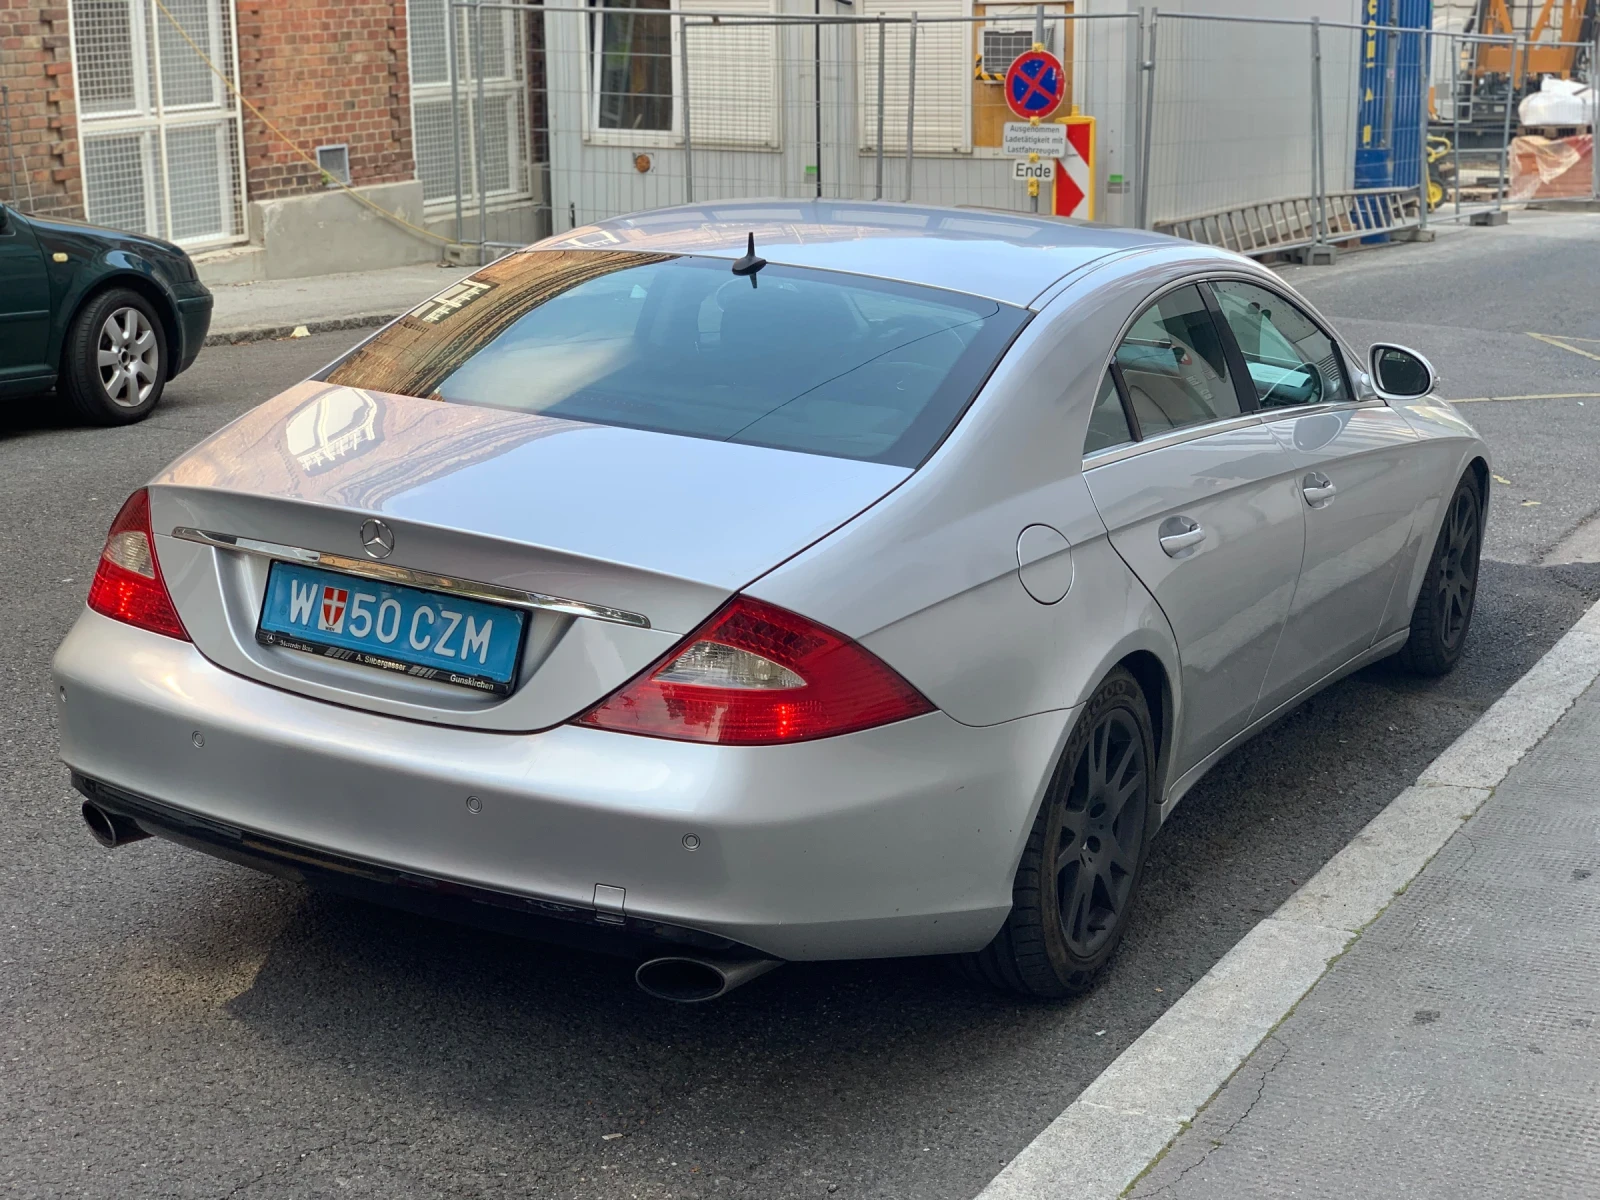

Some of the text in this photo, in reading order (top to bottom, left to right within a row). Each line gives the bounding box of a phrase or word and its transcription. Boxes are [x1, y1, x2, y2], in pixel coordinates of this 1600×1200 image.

[1010, 125, 1060, 133] Ausgenommen
[1005, 135, 1050, 144] Ladetätigkeit
[1007, 146, 1060, 155] Lastfahrzeugen
[1016, 163, 1051, 178] Ende
[290, 579, 493, 664] W 50 CZM
[450, 674, 494, 690] Gunskirchen
